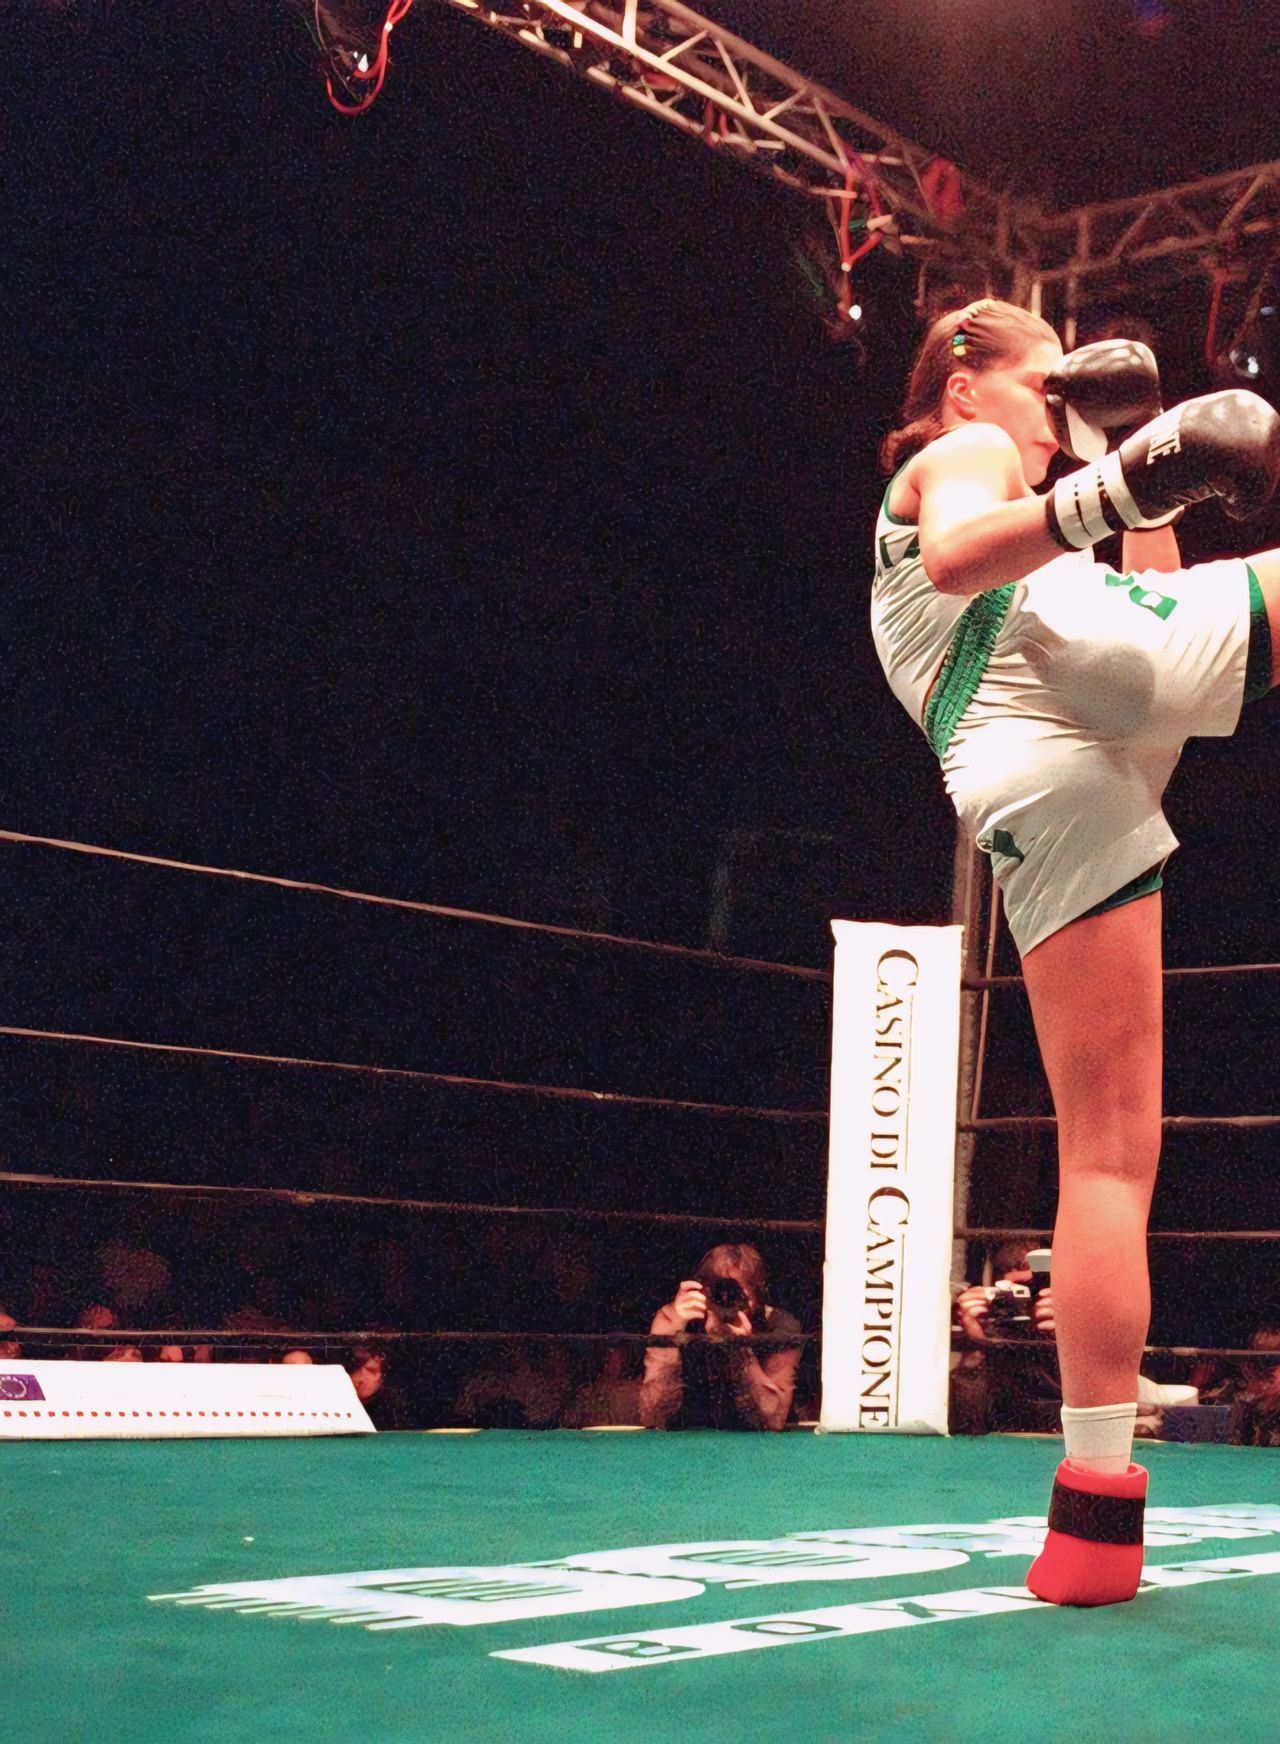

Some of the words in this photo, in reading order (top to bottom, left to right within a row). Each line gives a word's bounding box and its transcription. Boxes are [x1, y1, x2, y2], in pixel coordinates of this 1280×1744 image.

[871, 948, 920, 1118] CASINO
[869, 1132, 900, 1170] DI
[858, 1186, 911, 1429] CAMPIONE
